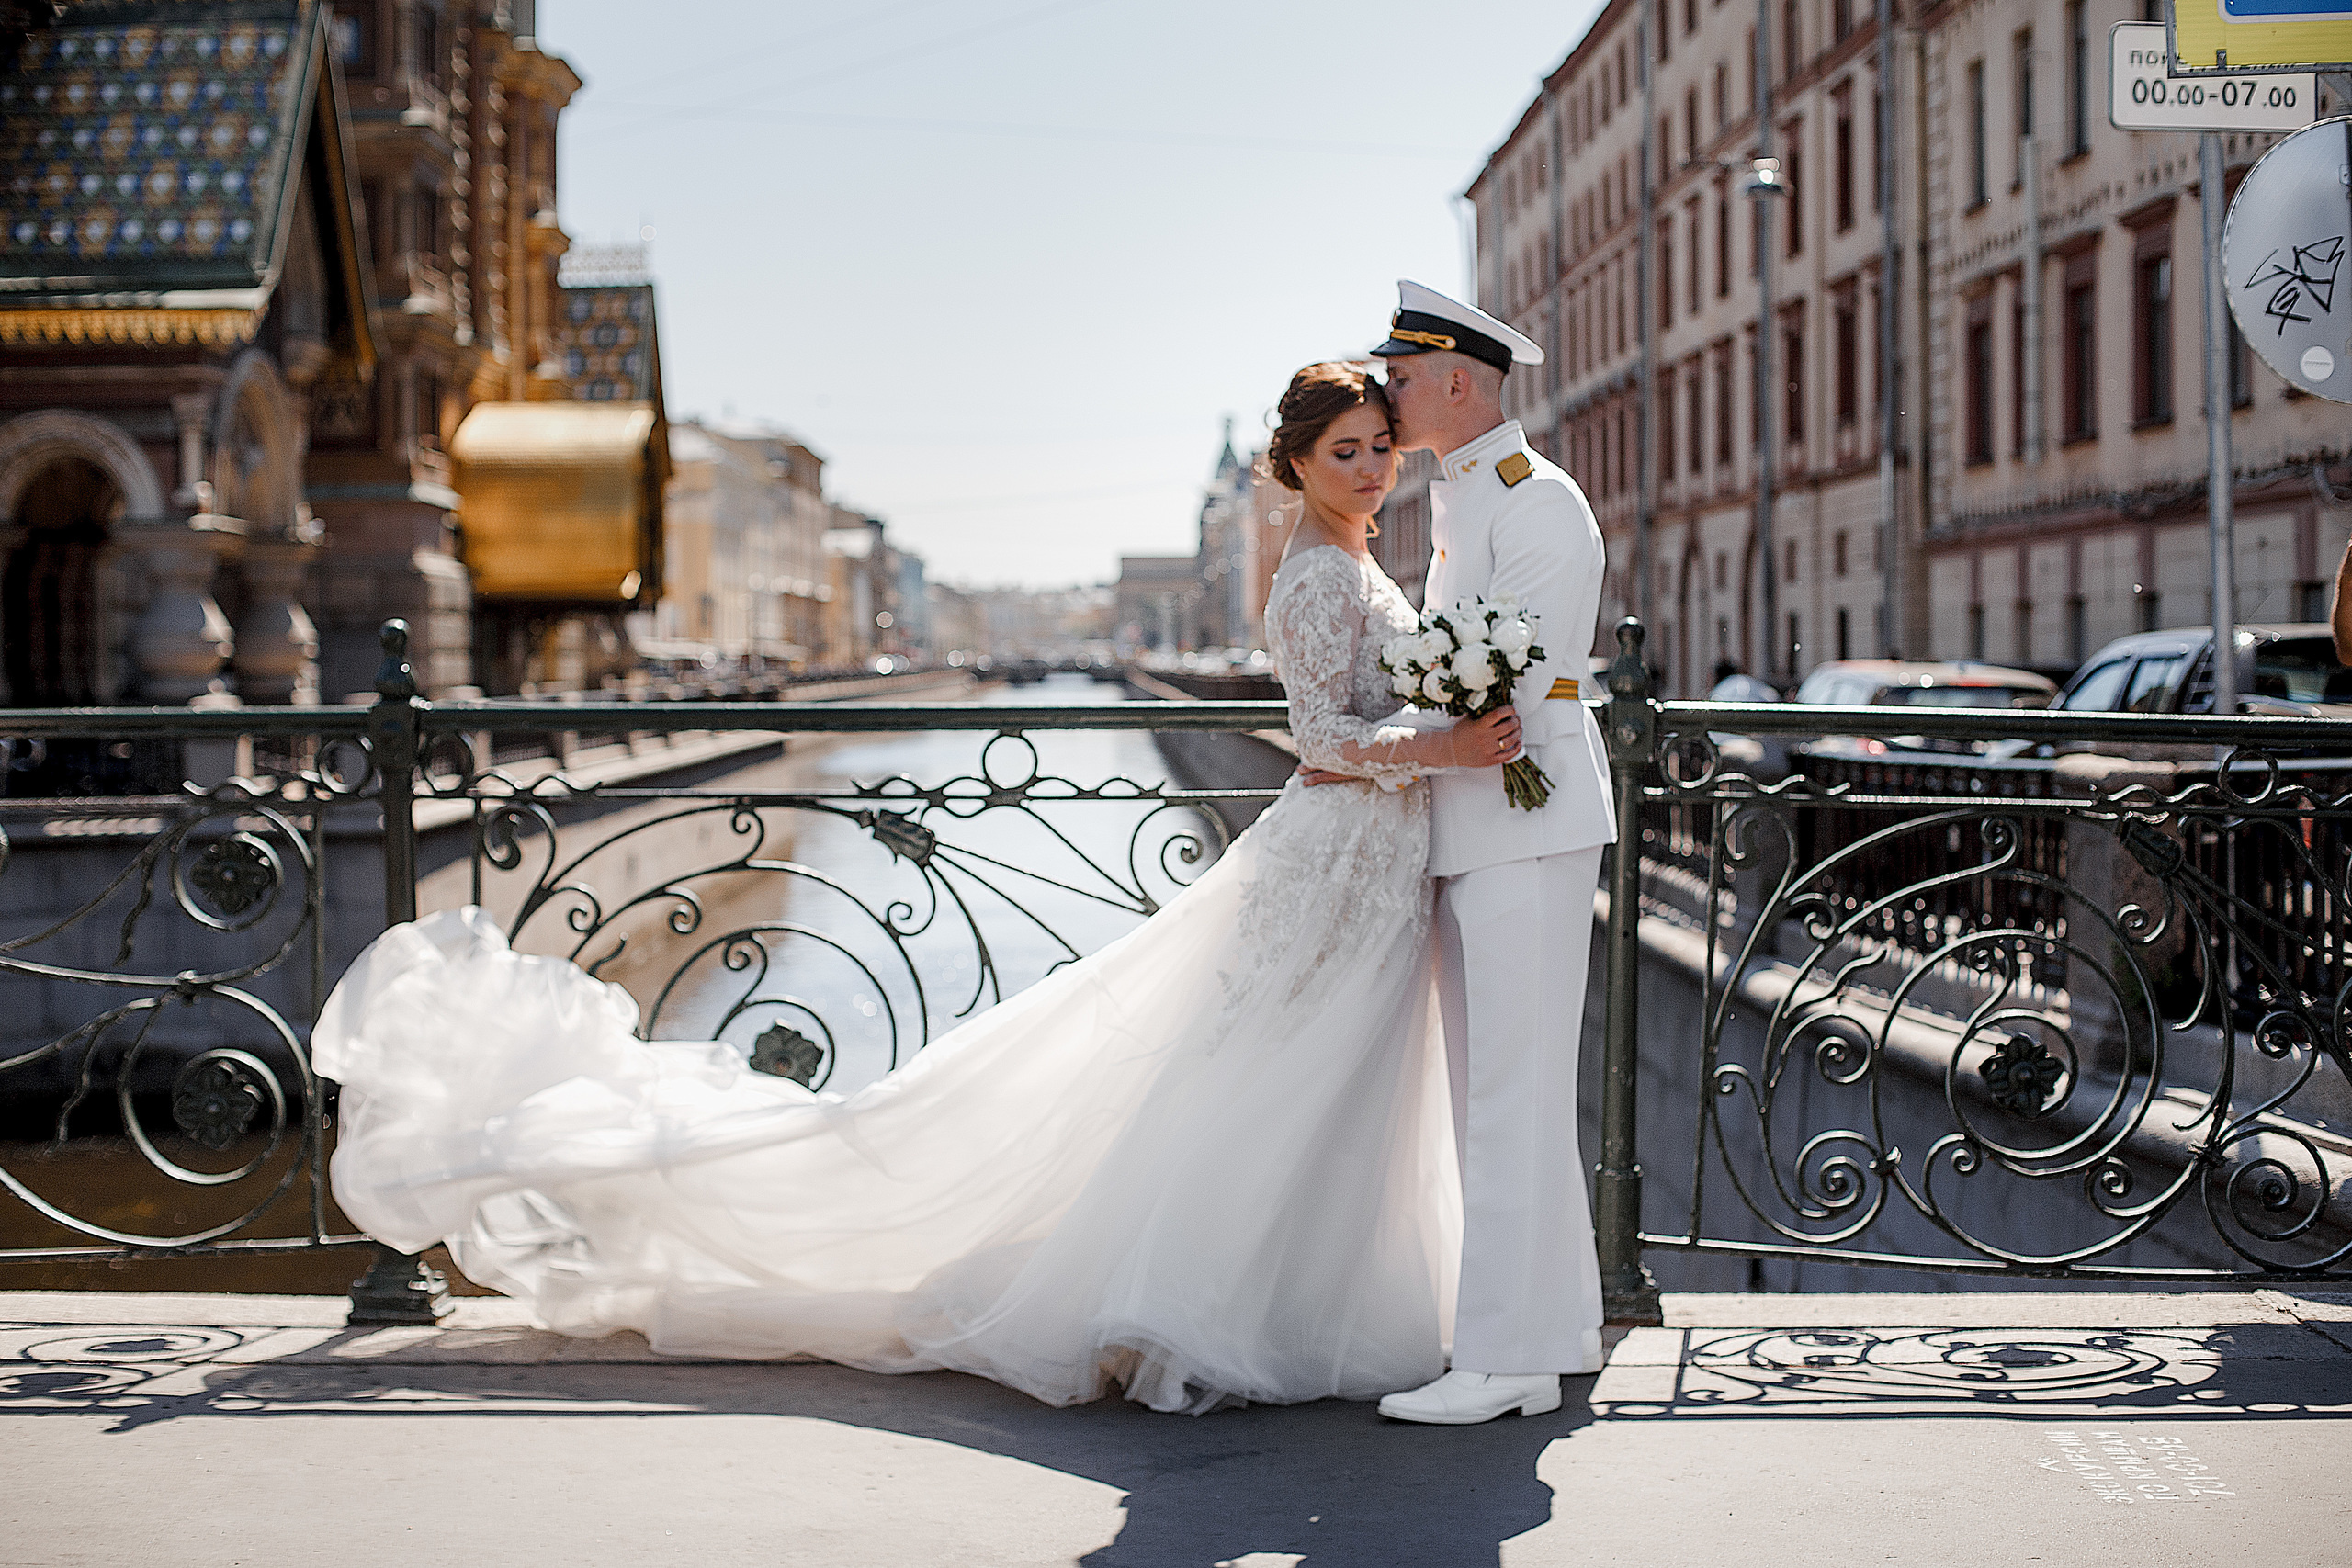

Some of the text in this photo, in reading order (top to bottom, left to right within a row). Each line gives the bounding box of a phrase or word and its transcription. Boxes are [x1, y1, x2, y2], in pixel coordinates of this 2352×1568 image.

[2043, 1431, 2134, 1504] ЭКСКУРСИИ
[2091, 1431, 2180, 1500] ПО КРЫШАМ
